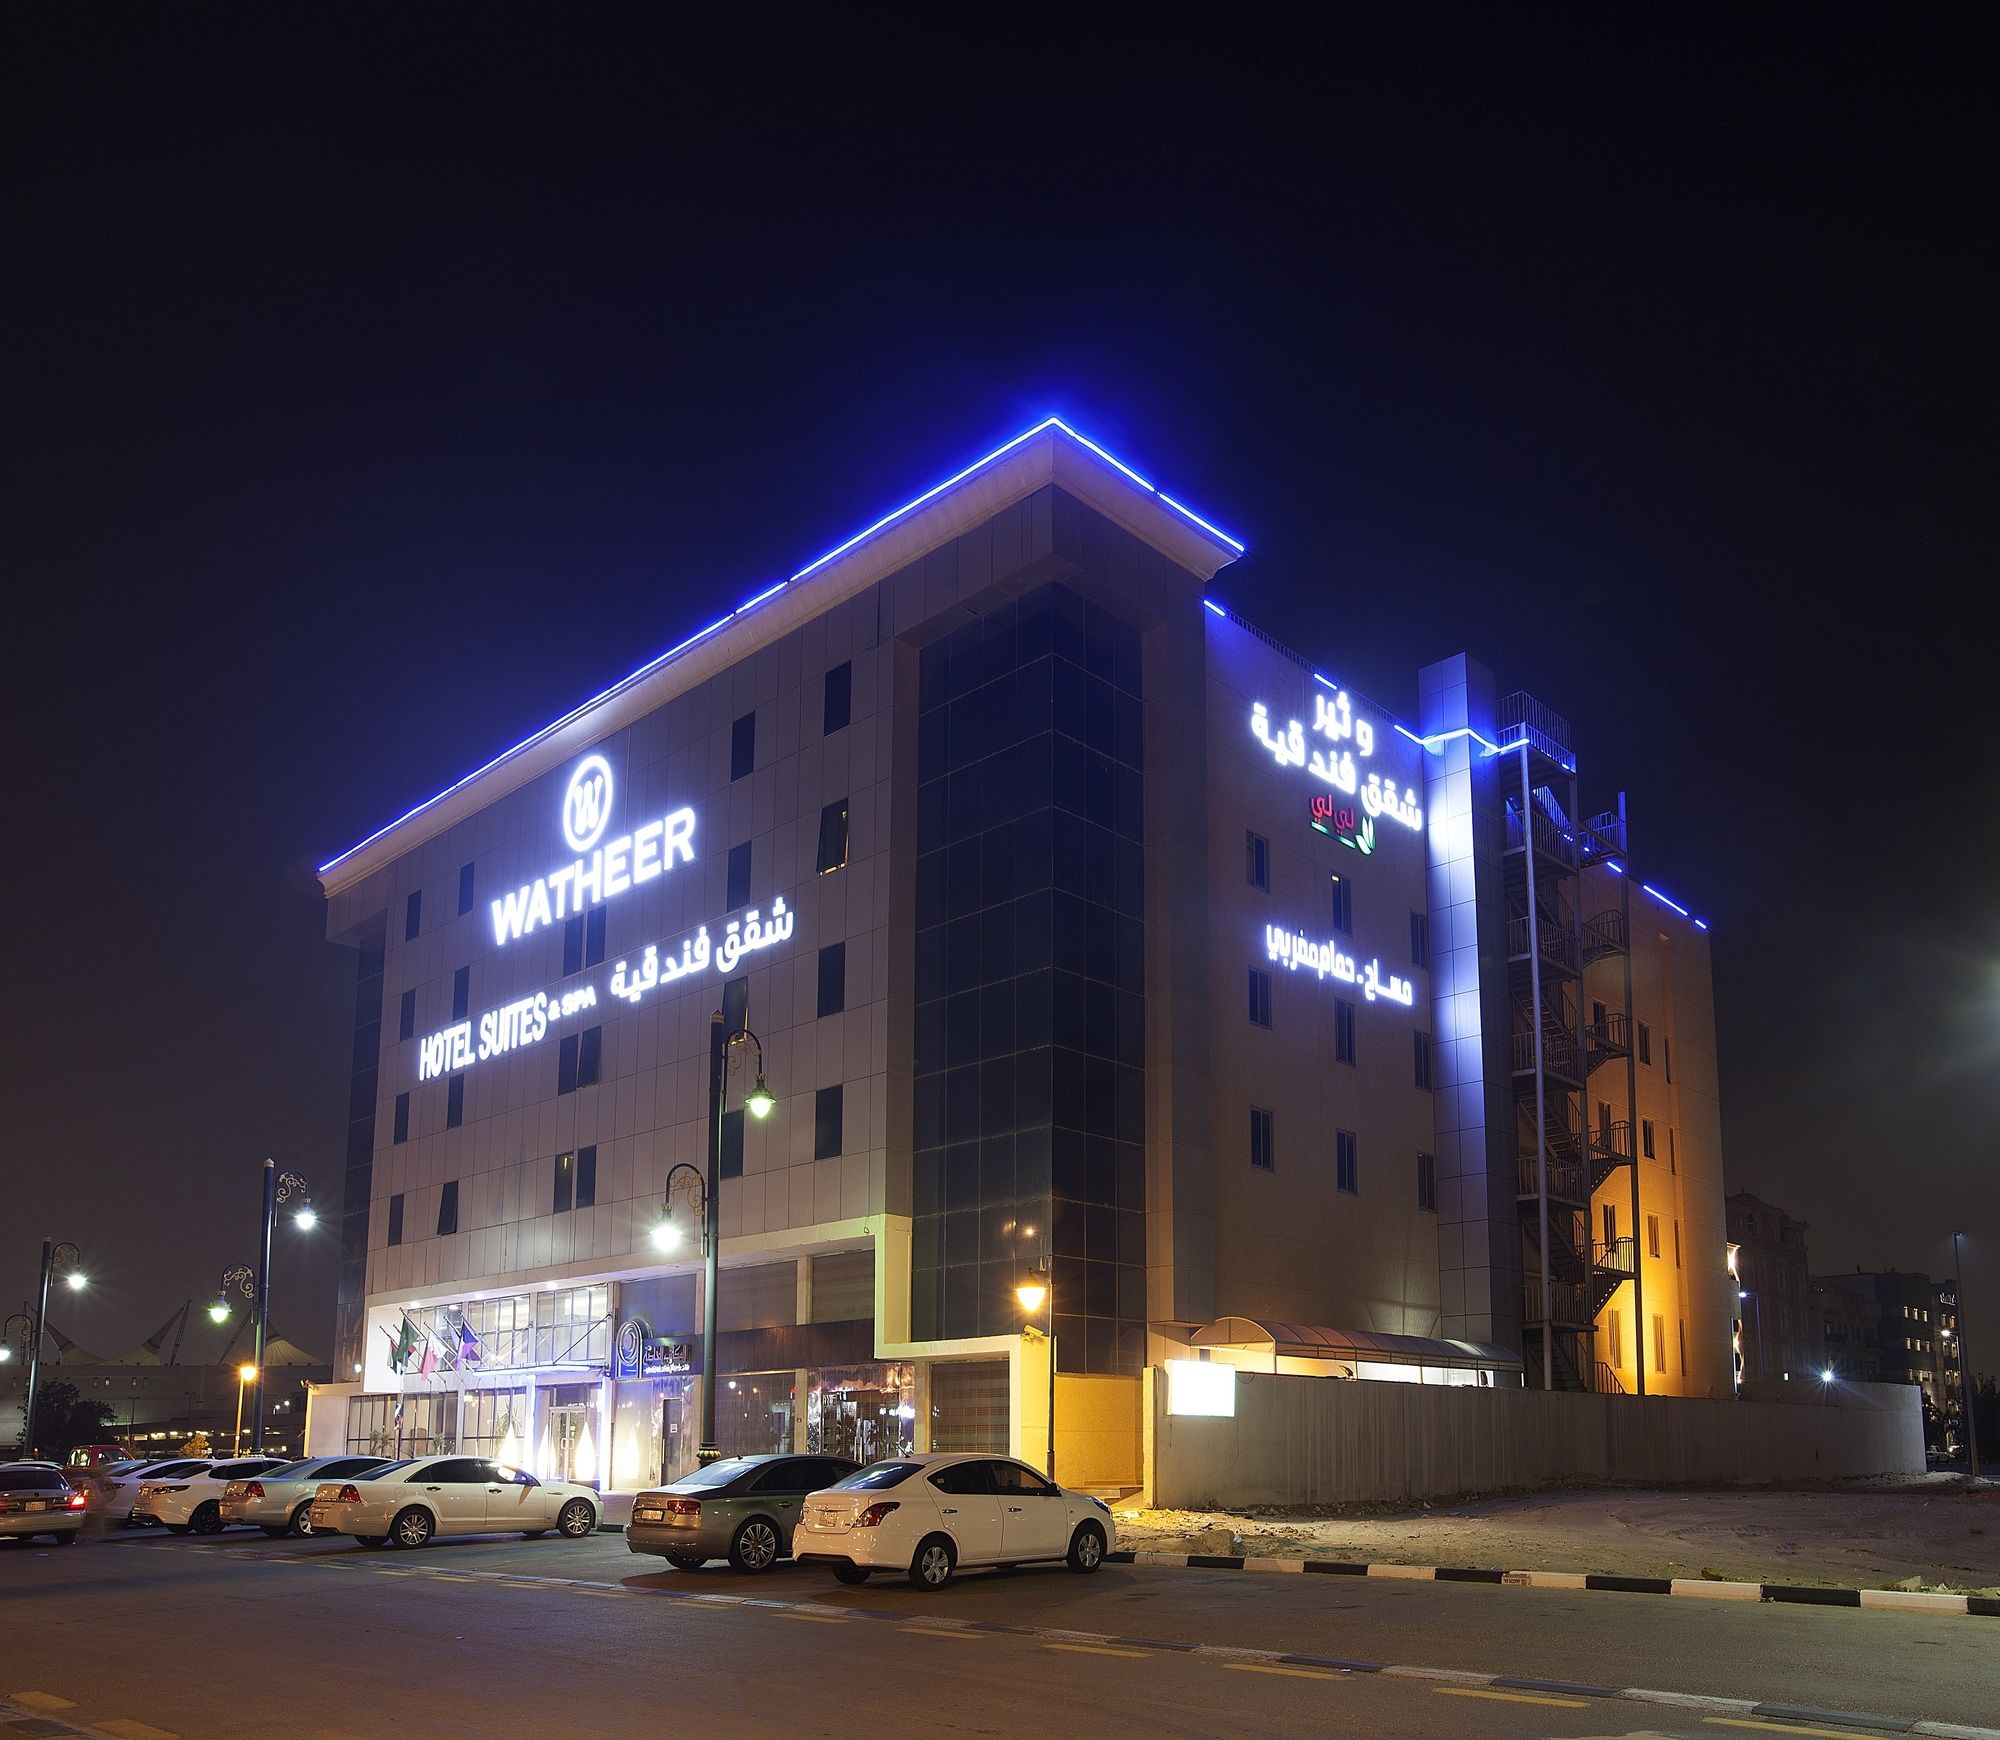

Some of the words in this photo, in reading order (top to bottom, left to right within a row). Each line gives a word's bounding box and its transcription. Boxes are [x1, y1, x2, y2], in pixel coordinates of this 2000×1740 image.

[1250, 702, 1357, 795] فندقية
[1360, 773, 1422, 831] شقق
[491, 807, 696, 946] WATHEER
[610, 925, 711, 1003] فندقية
[716, 896, 794, 973] شقق
[419, 1020, 476, 1081] HOTEL
[478, 991, 548, 1061] SUITES
[548, 1000, 561, 1022] &
[561, 985, 597, 1016] SPA
